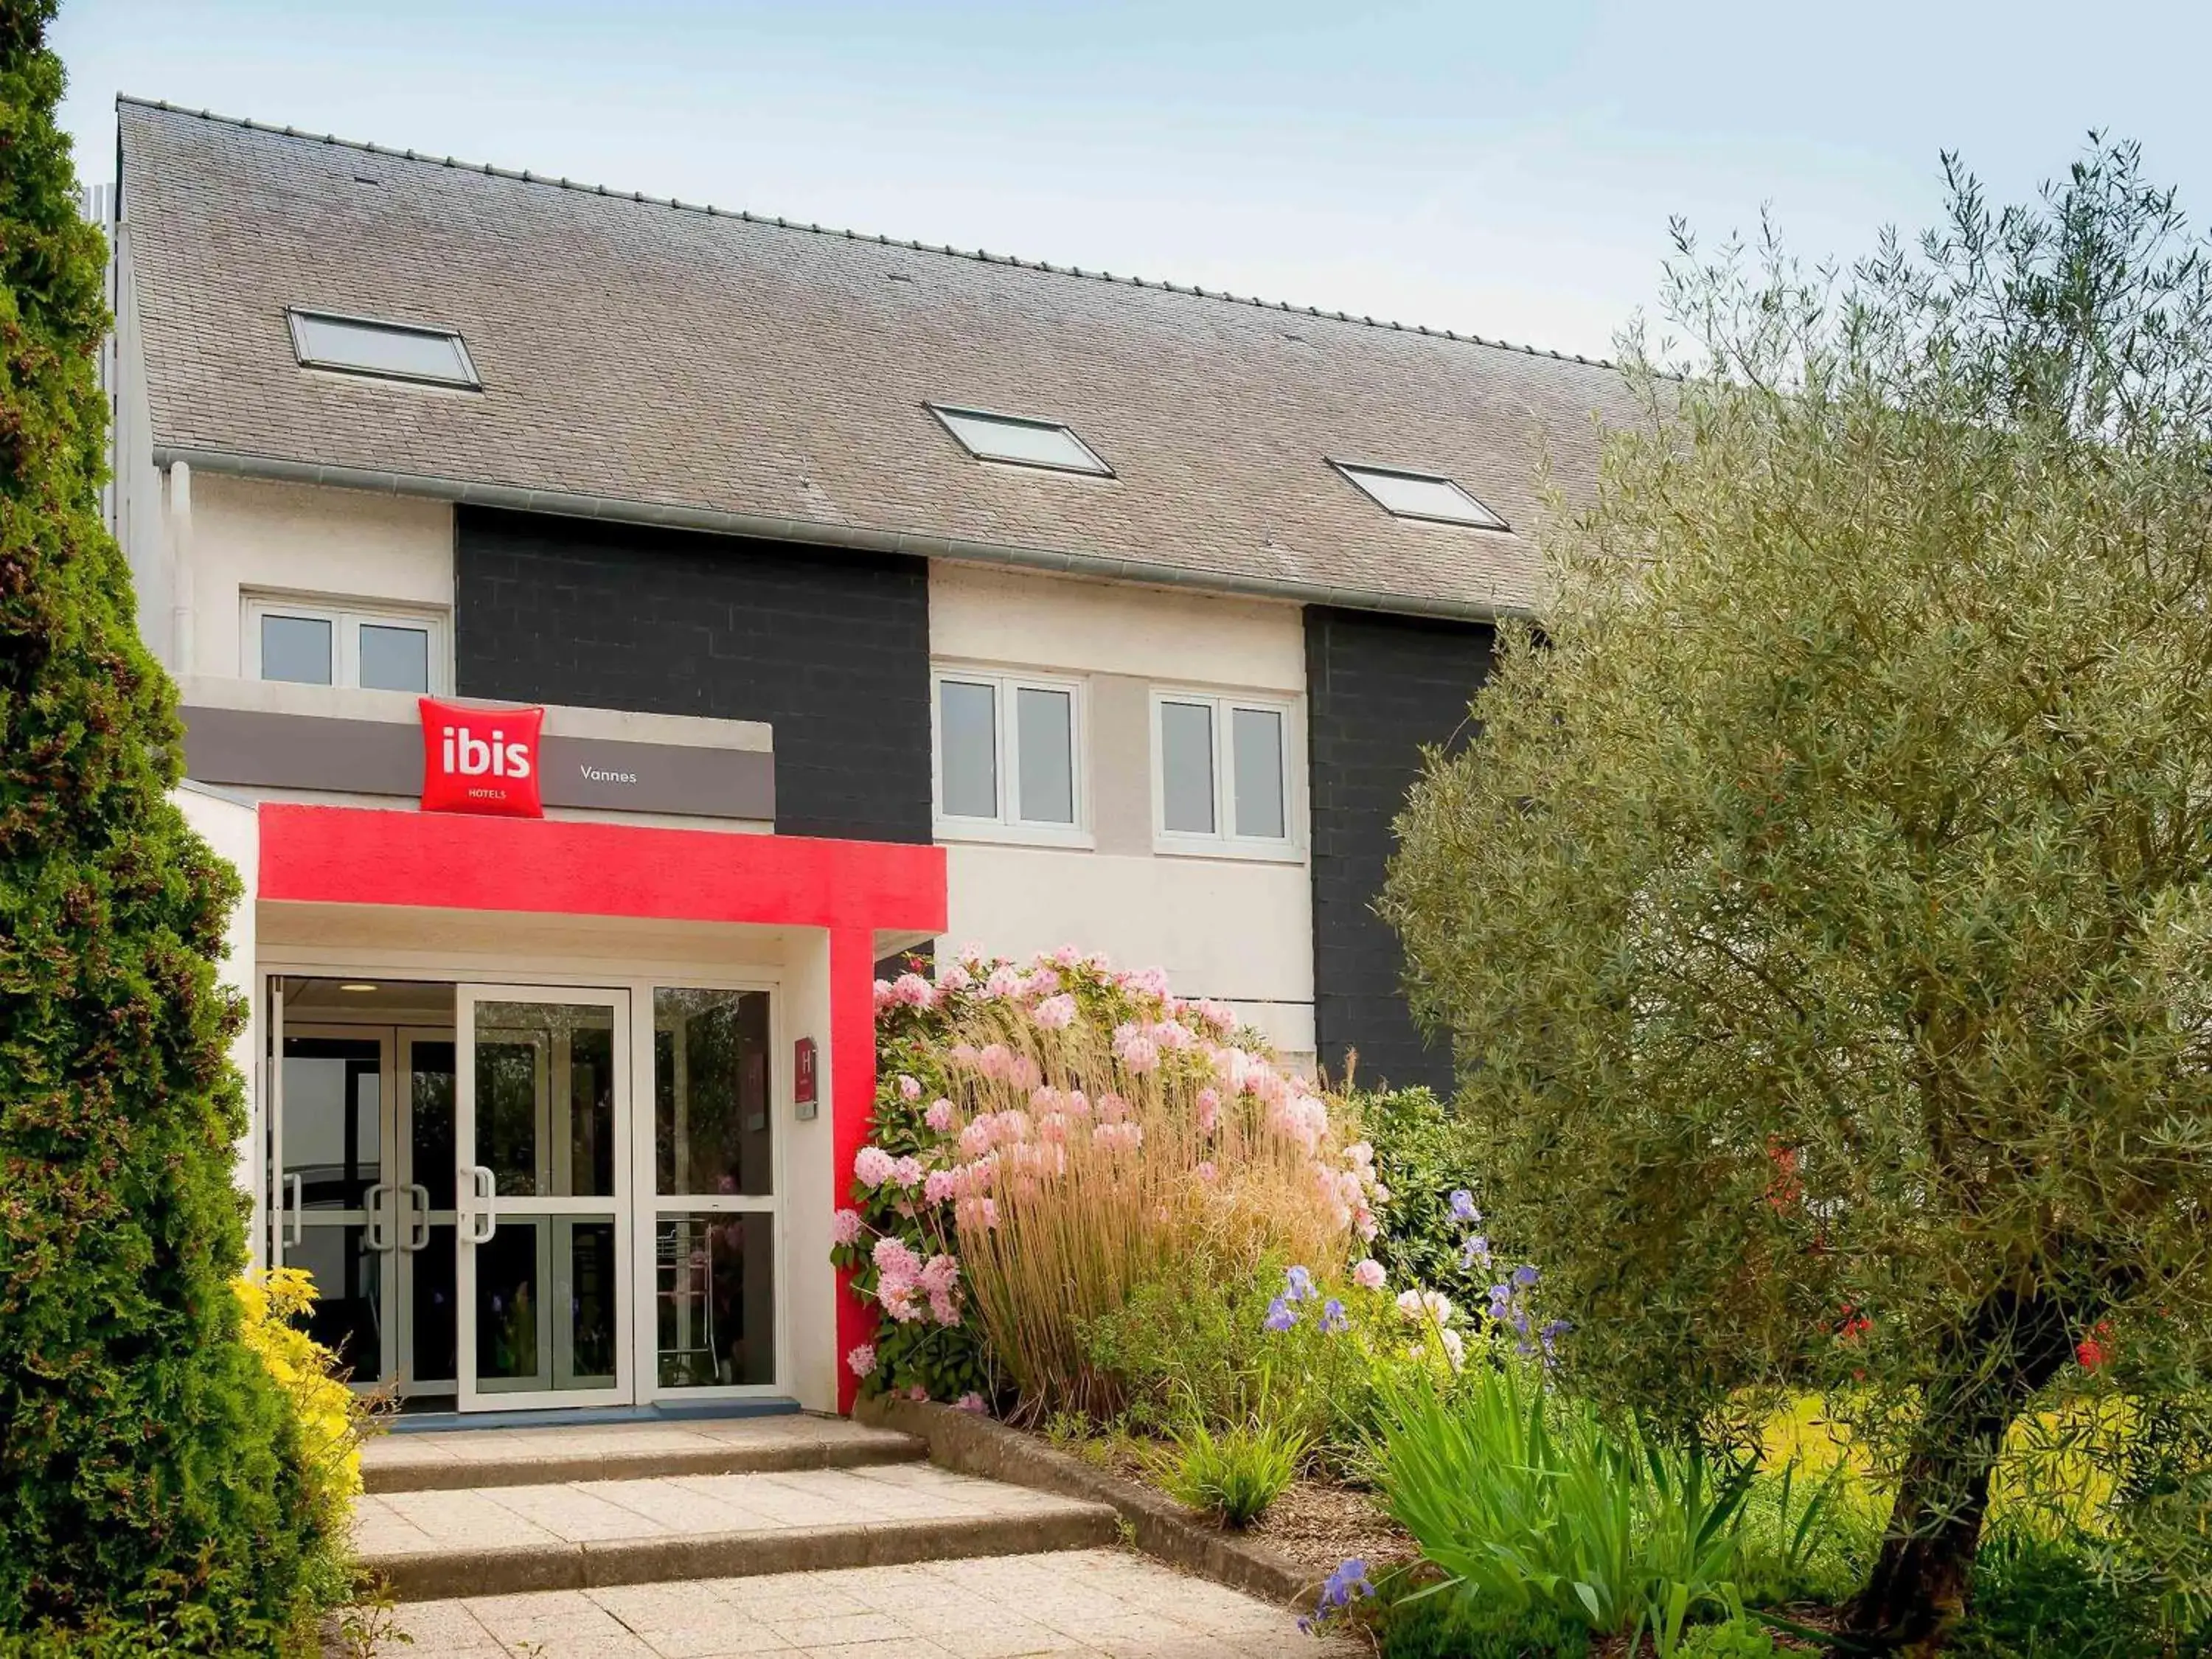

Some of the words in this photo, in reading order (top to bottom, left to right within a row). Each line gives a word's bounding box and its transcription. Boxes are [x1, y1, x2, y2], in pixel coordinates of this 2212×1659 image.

[443, 726, 530, 778] ibis
[580, 765, 636, 783] Vannes
[468, 789, 507, 799] HOTELS
